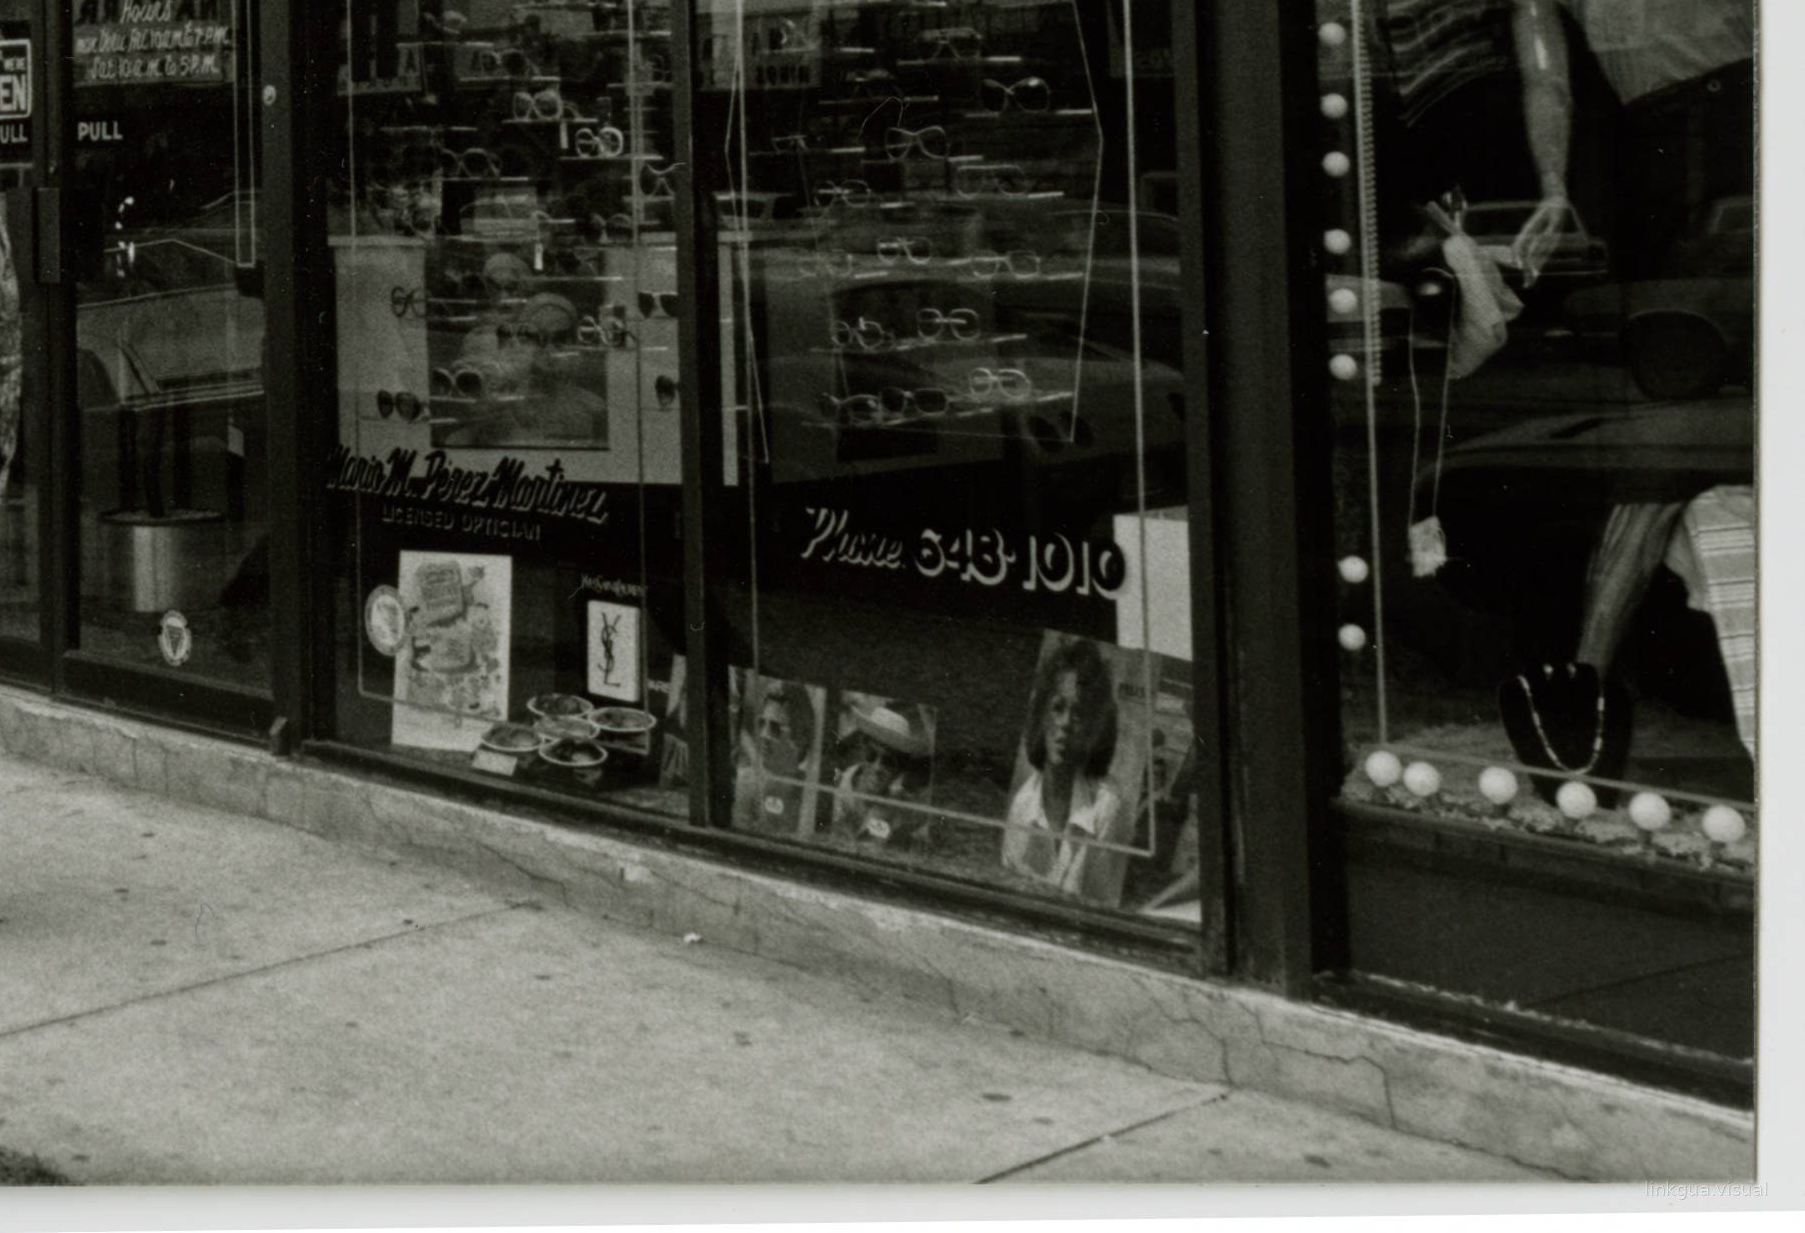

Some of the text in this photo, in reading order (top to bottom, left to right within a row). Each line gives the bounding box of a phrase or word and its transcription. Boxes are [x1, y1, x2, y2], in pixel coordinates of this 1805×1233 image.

[77, 121, 123, 142] PULL
[382, 503, 542, 543] LICENSED OPTICIAN
[800, 506, 906, 570] Phone
